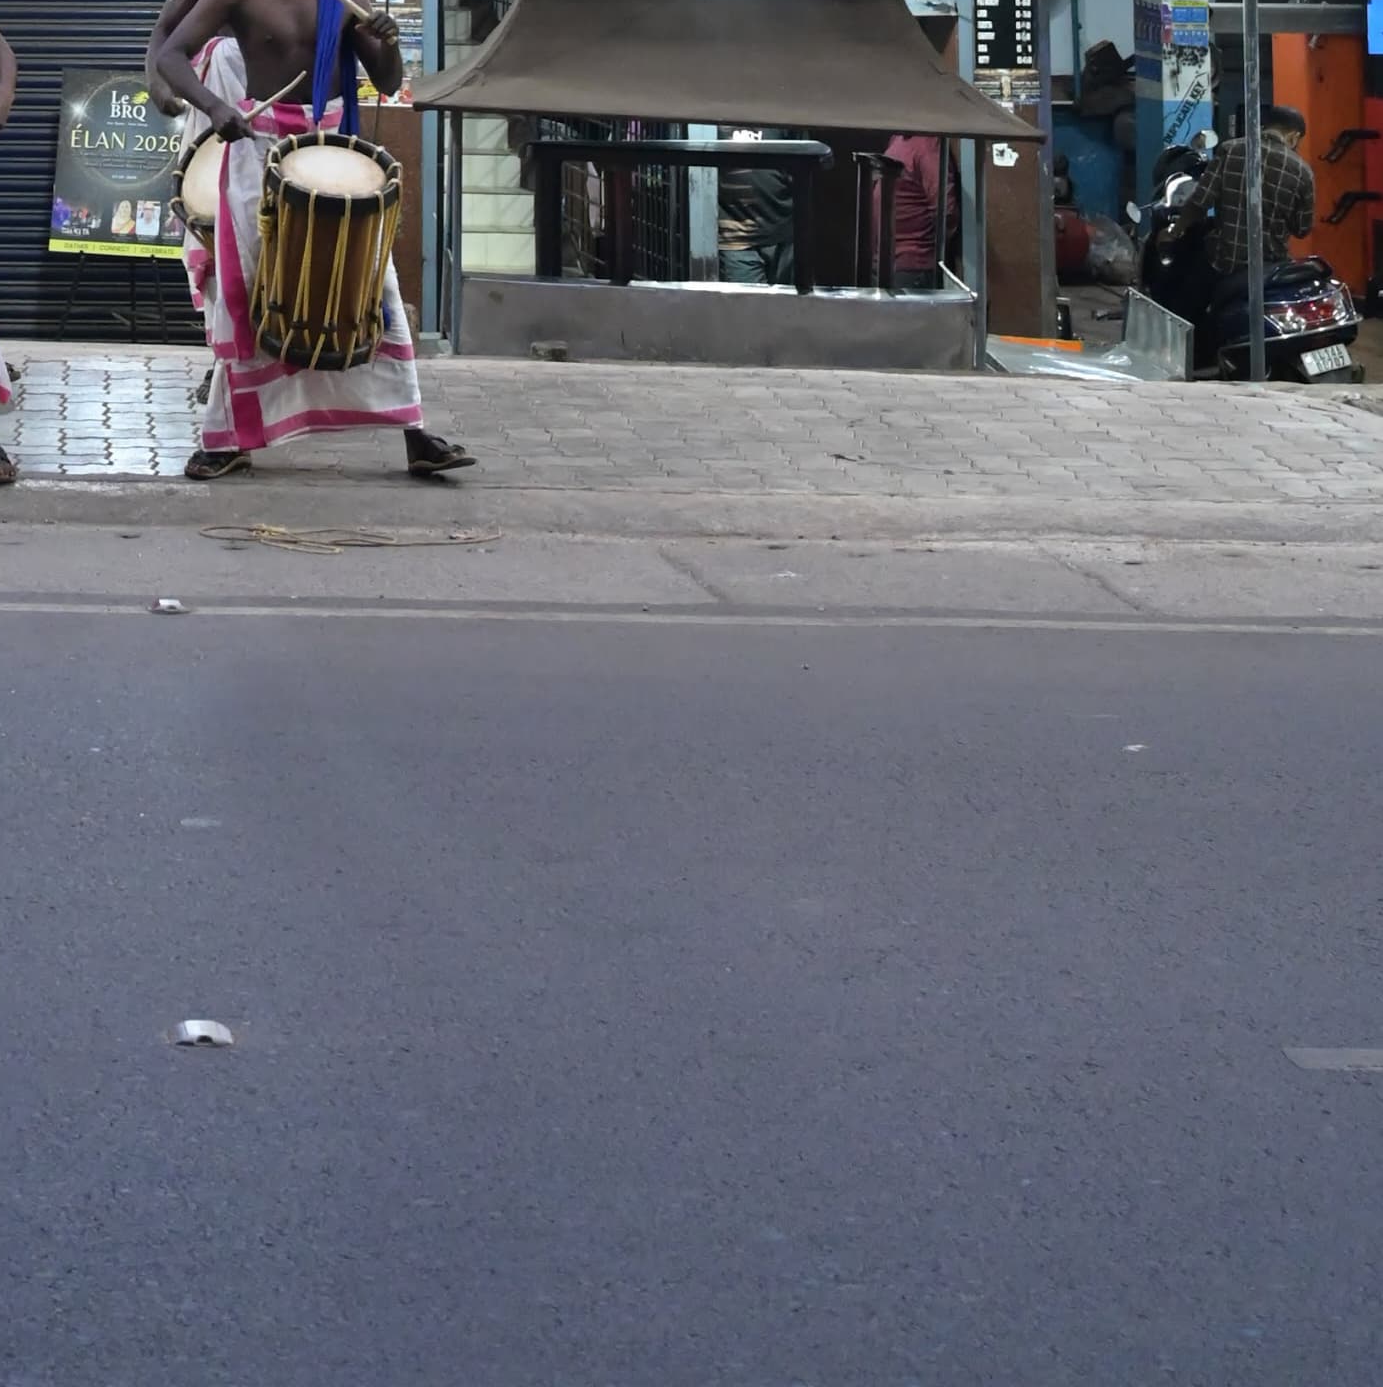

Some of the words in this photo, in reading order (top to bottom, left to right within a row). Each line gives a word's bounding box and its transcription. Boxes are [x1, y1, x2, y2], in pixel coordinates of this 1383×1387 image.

[111, 90, 129, 105] Le
[1189, 80, 1204, 100] KEY
[109, 104, 147, 123] BRQ
[70, 123, 126, 150] ÉLAN
[133, 133, 182, 154] 2026
